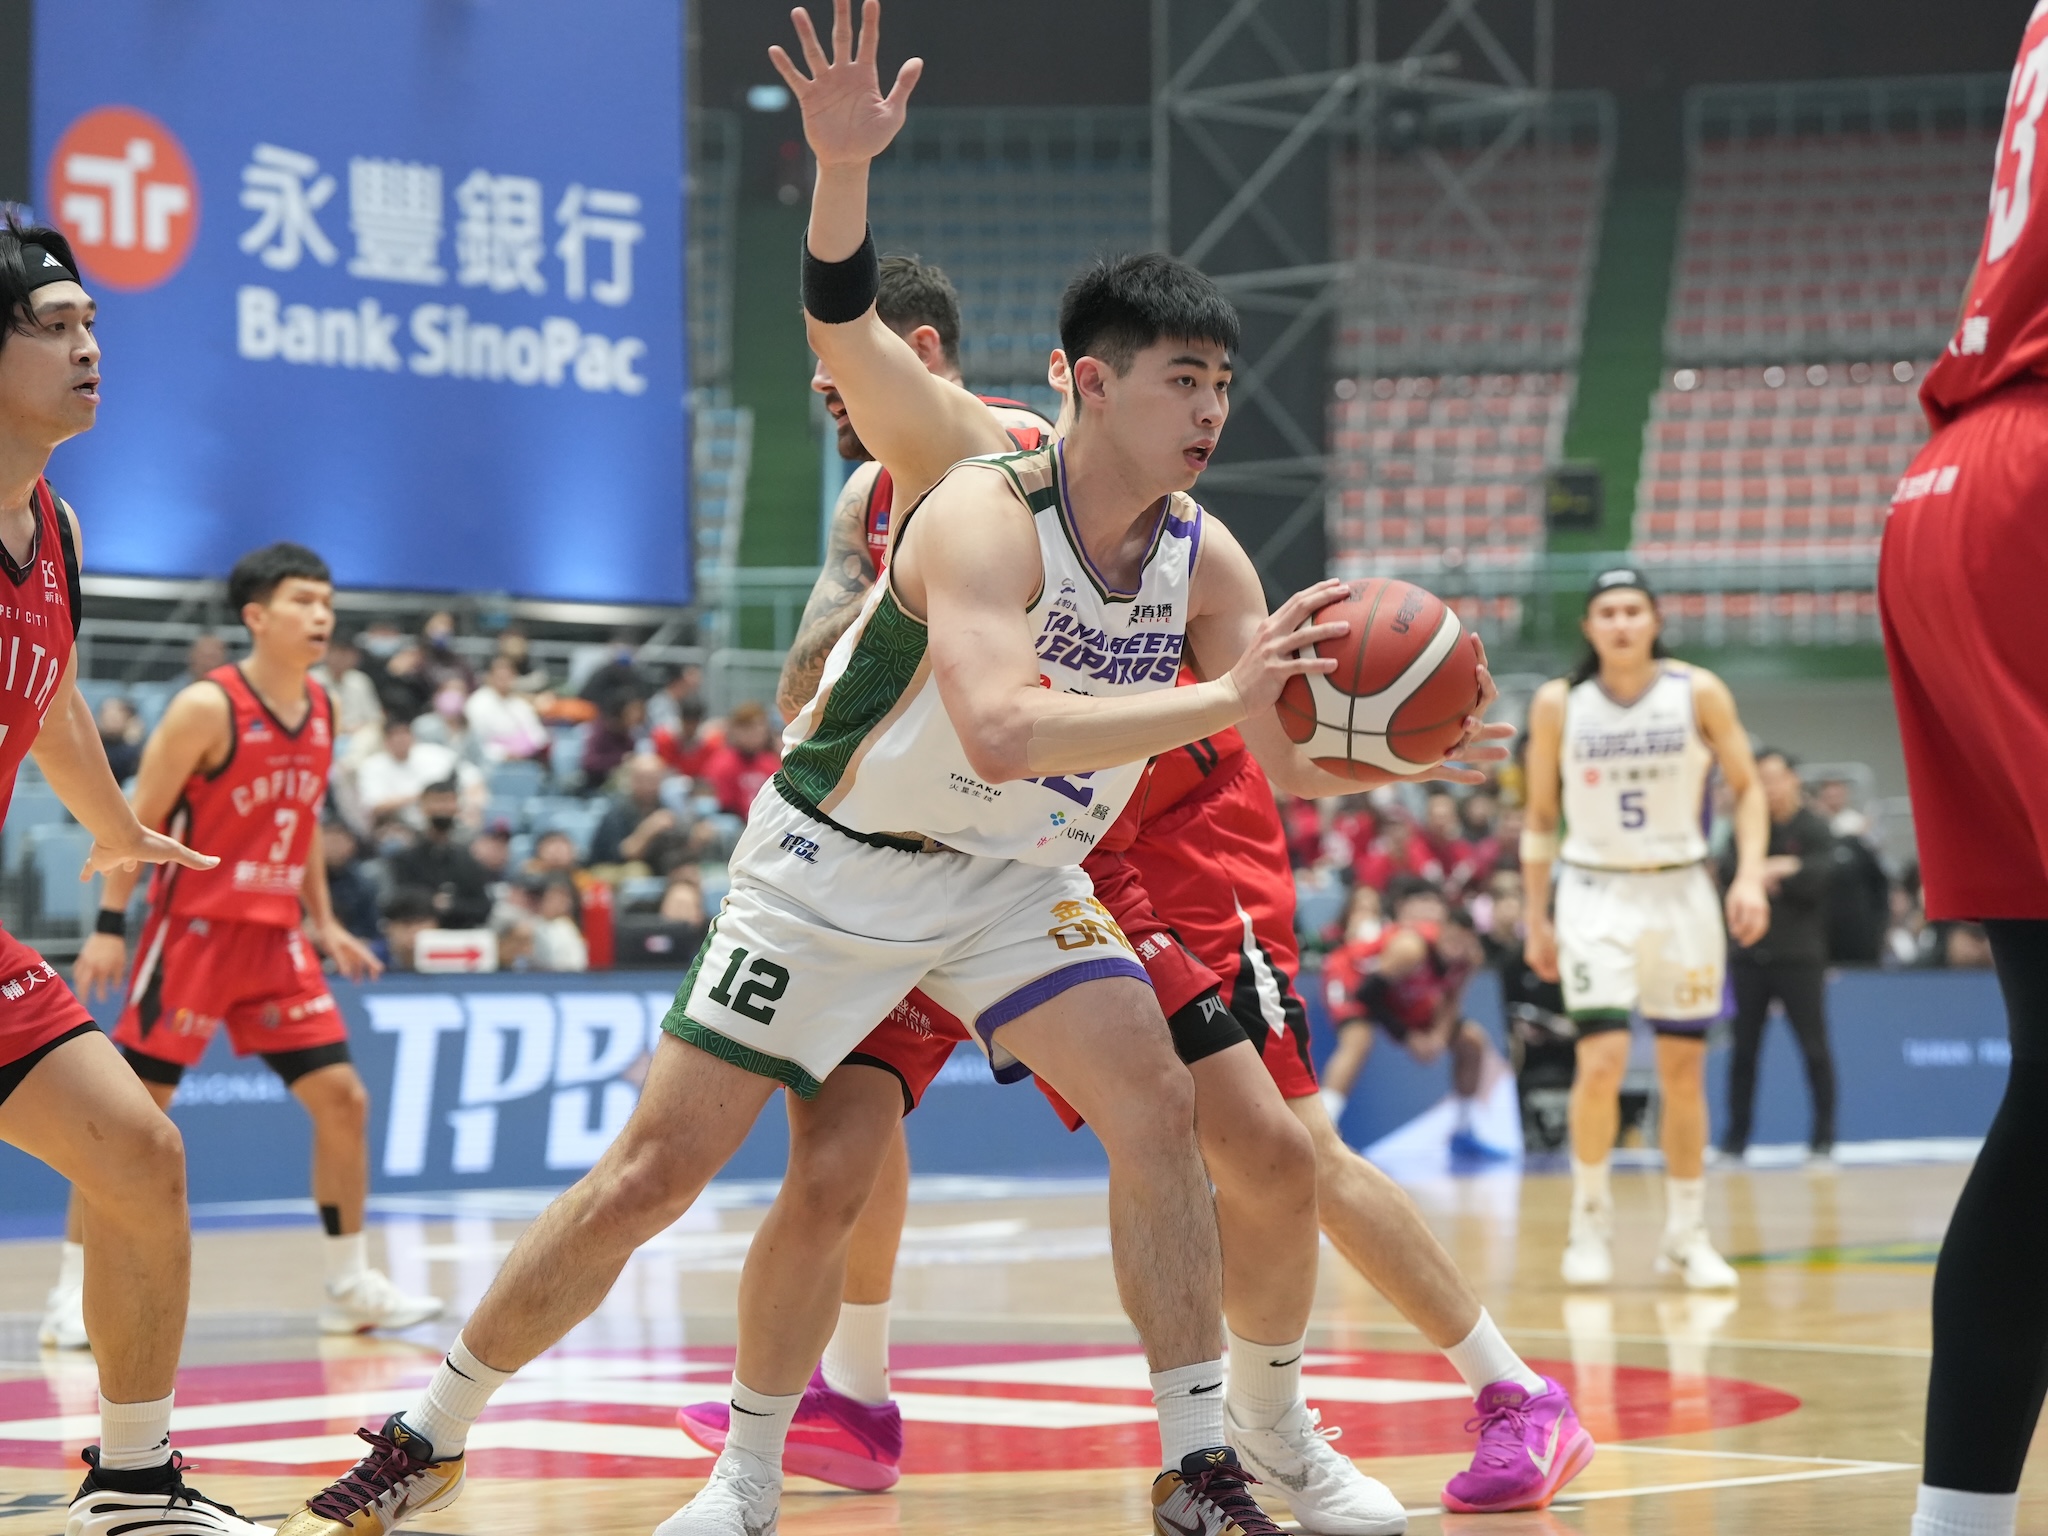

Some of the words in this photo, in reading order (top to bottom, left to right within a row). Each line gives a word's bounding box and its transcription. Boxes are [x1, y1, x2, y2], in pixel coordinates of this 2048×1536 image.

[239, 142, 645, 306] 永豐銀行
[236, 286, 403, 372] Bank
[408, 304, 647, 395] SinoPac
[268, 807, 299, 862] 3
[1619, 791, 1646, 829] 5
[708, 947, 790, 1026] 12
[1572, 962, 1592, 994] 5
